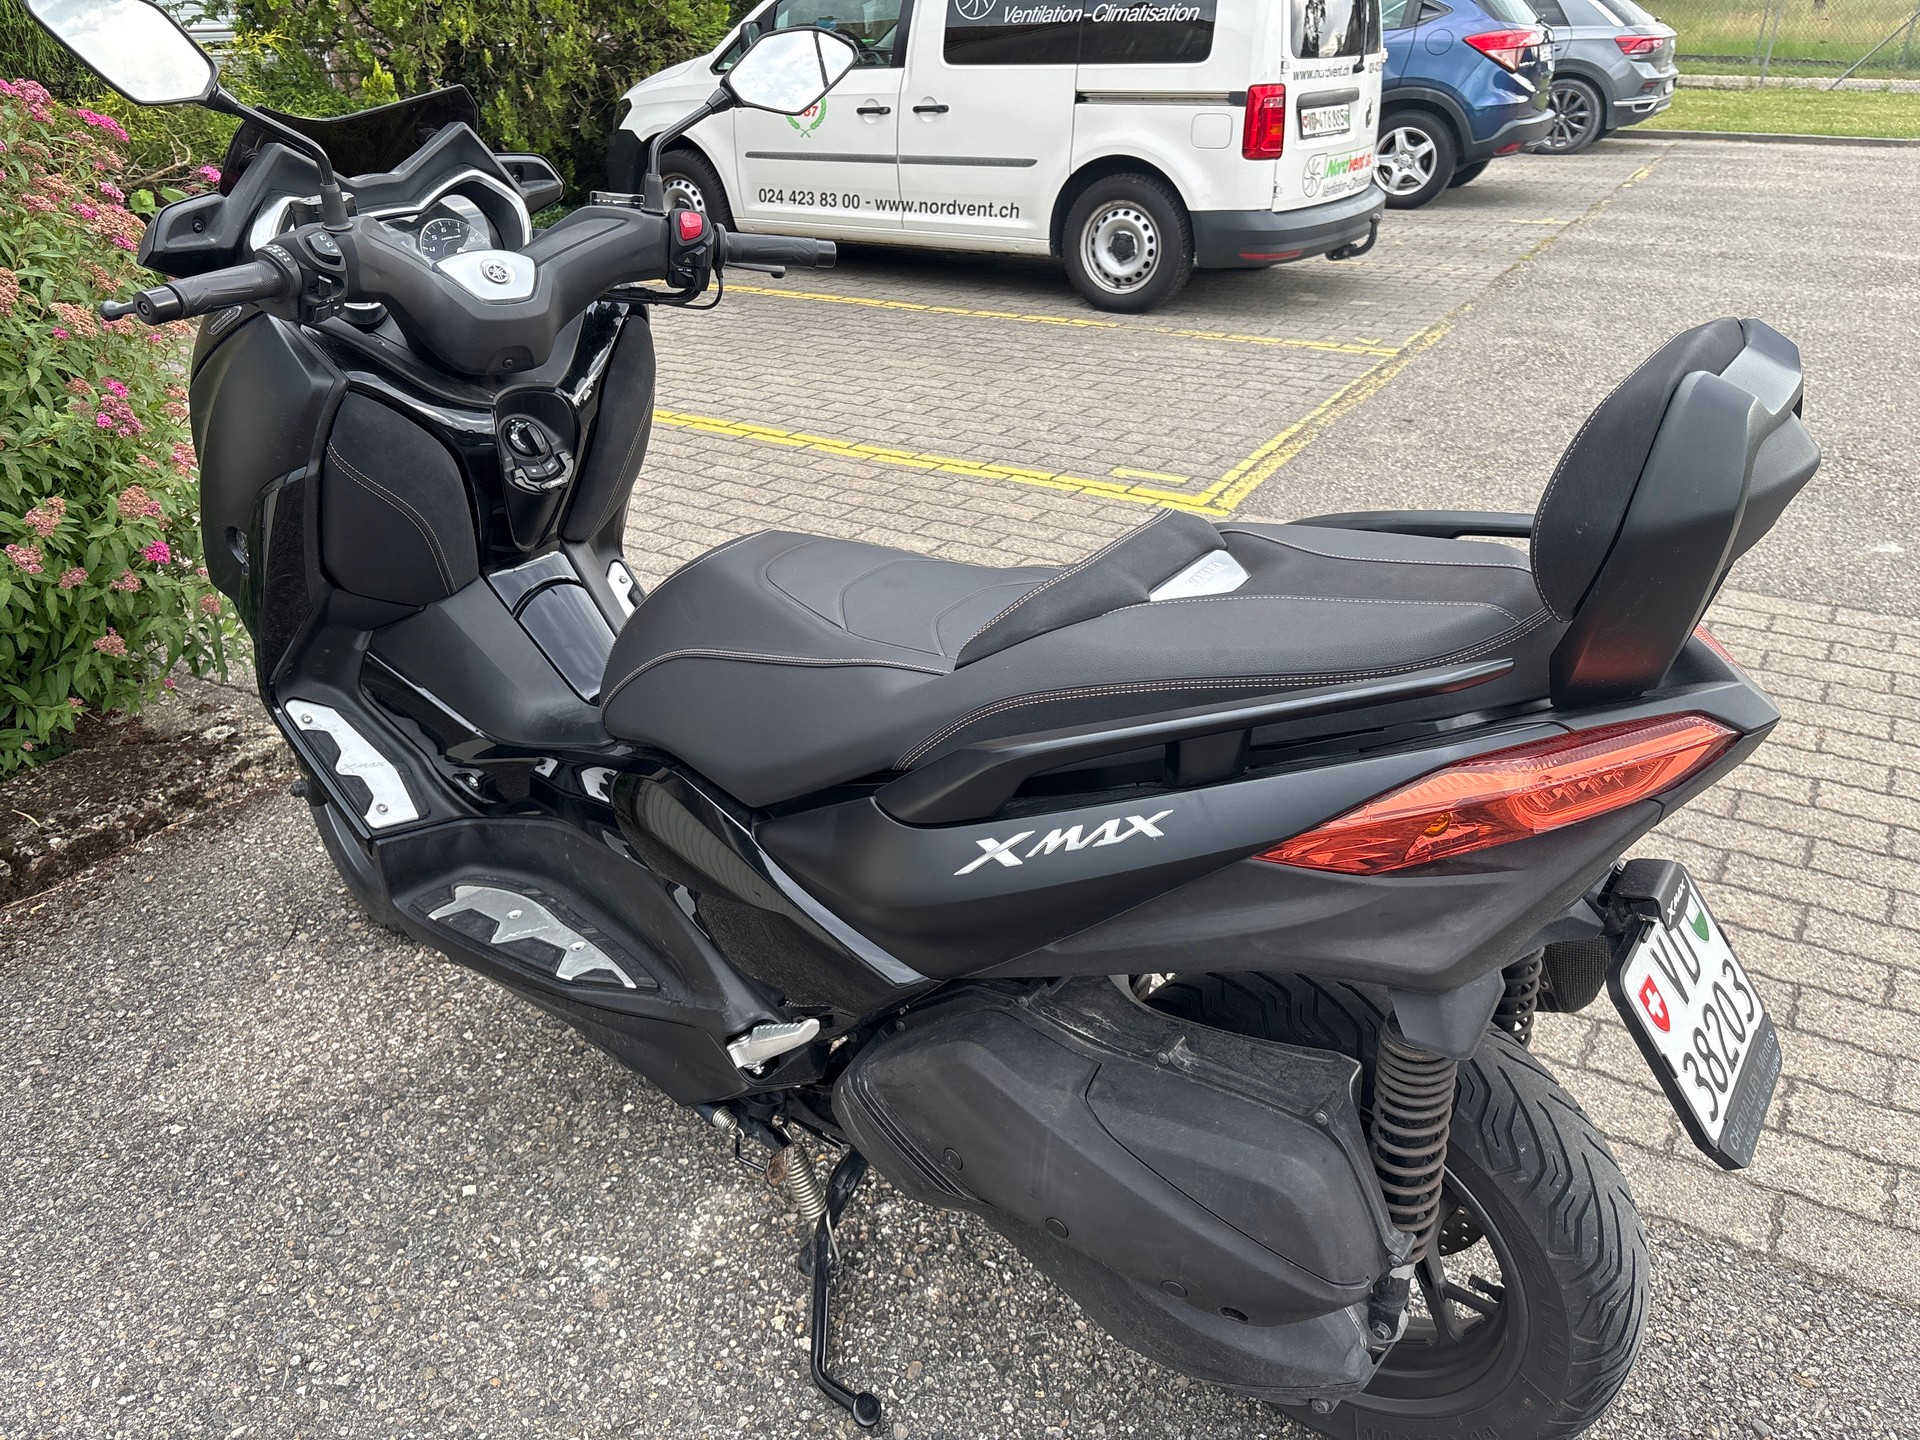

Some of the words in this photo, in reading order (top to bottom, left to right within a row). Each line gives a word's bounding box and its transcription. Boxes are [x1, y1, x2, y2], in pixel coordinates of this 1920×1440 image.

[758, 188, 784, 204] 024
[788, 190, 815, 206] 423
[820, 192, 837, 208] 83
[842, 194, 860, 210] 00
[875, 198, 1020, 219] www.nordvent.ch
[1650, 925, 1701, 1006] VD
[1682, 958, 1755, 1122] 38203
[1729, 1074, 1762, 1151] CHEVALLEY
[1755, 1030, 1775, 1075] Motos
